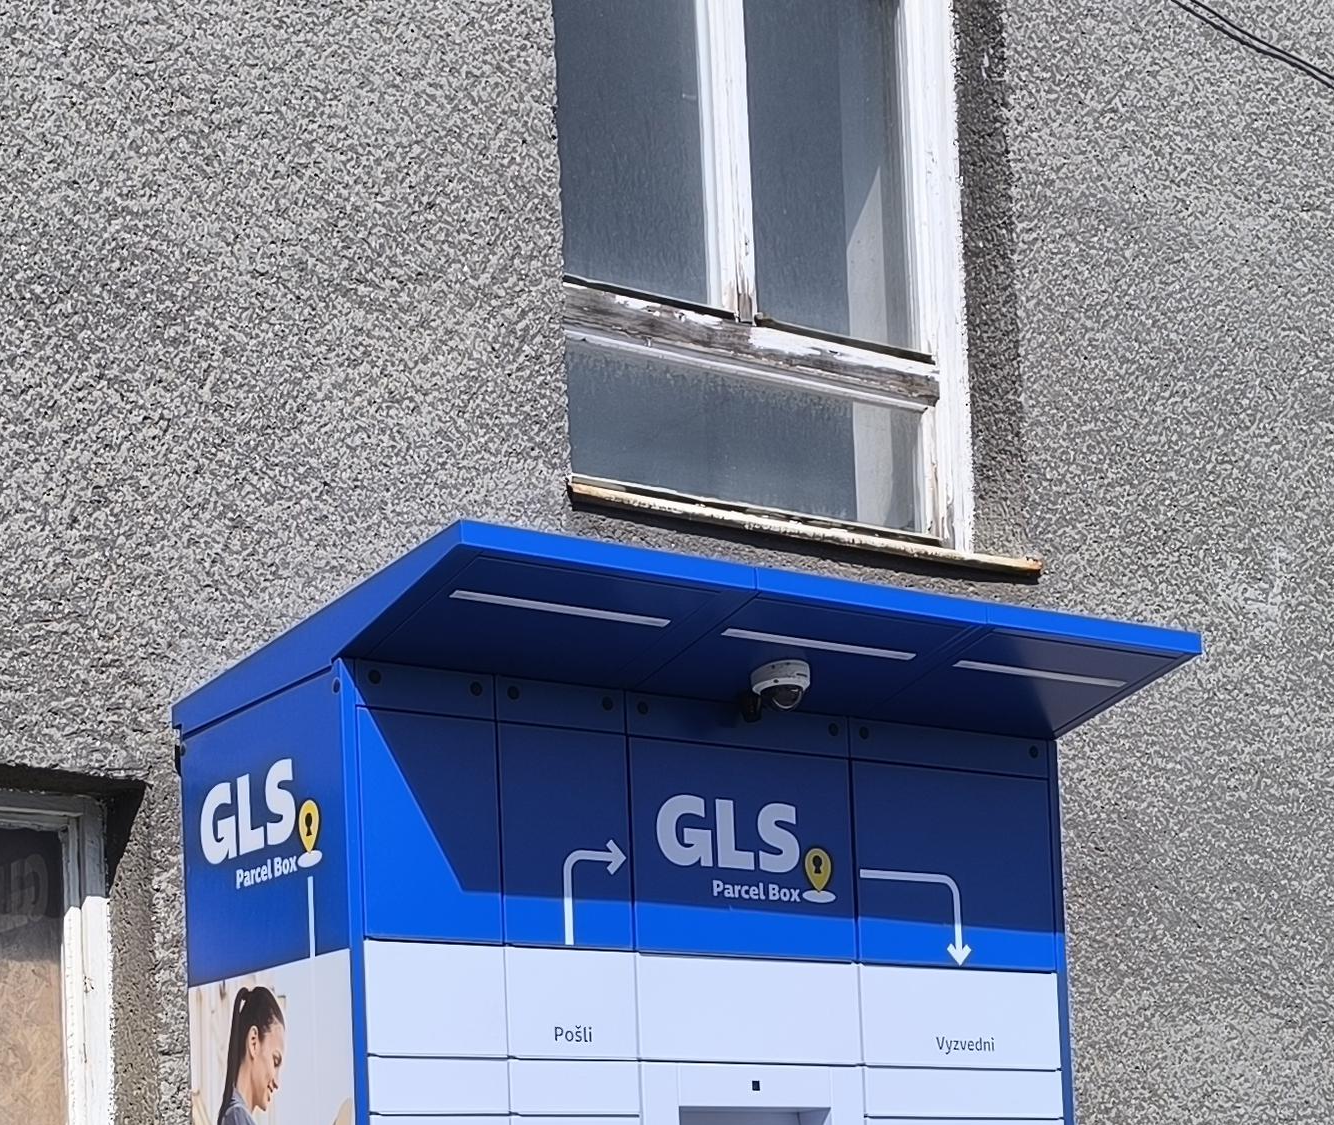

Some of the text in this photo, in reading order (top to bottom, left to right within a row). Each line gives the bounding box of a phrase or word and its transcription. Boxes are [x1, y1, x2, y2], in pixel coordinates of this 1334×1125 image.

[200, 758, 296, 864] GLS
[656, 794, 801, 873] GLS
[236, 856, 298, 889] Parcel Box
[712, 880, 801, 903] Parcel Box
[554, 1024, 593, 1043] Pošli
[935, 1036, 995, 1055] Vyzvedni
